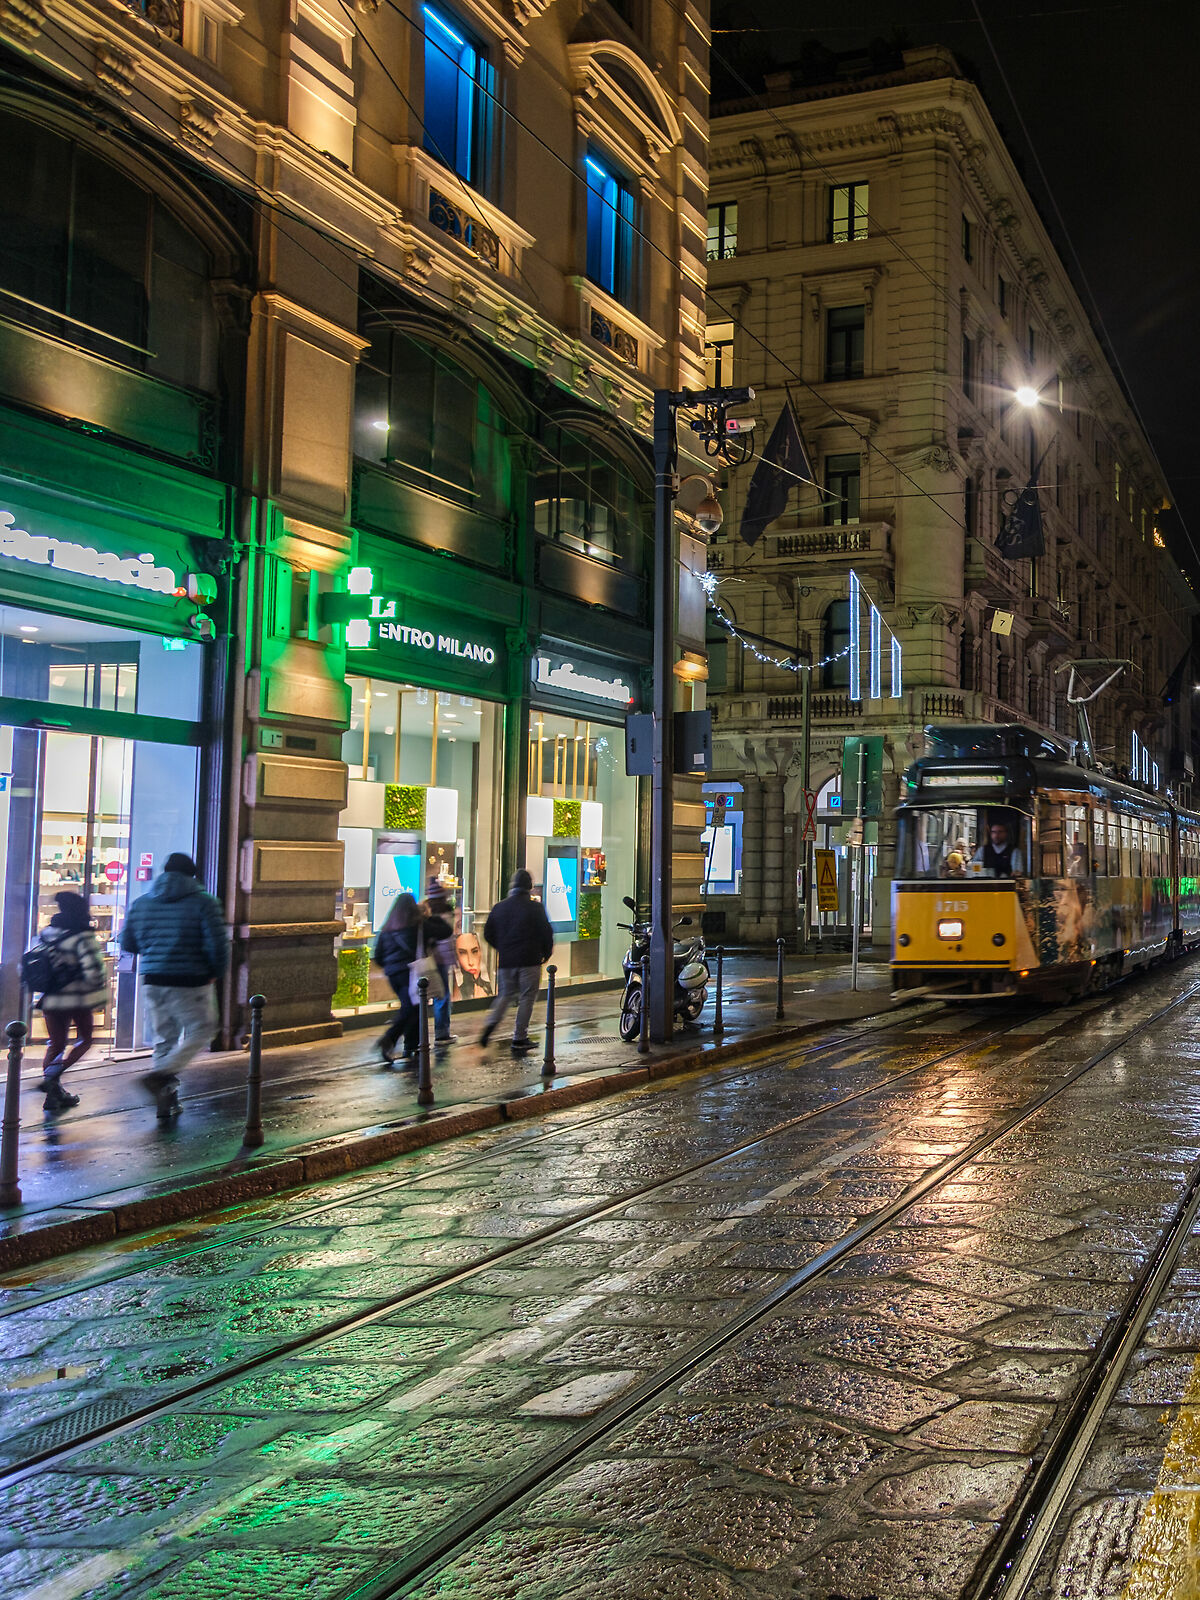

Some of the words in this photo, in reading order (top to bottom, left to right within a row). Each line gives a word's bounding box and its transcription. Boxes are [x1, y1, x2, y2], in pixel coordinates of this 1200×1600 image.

[1000, 619, 1006, 627] 7
[379, 622, 434, 649] ENTRO
[437, 634, 495, 664] MILANO
